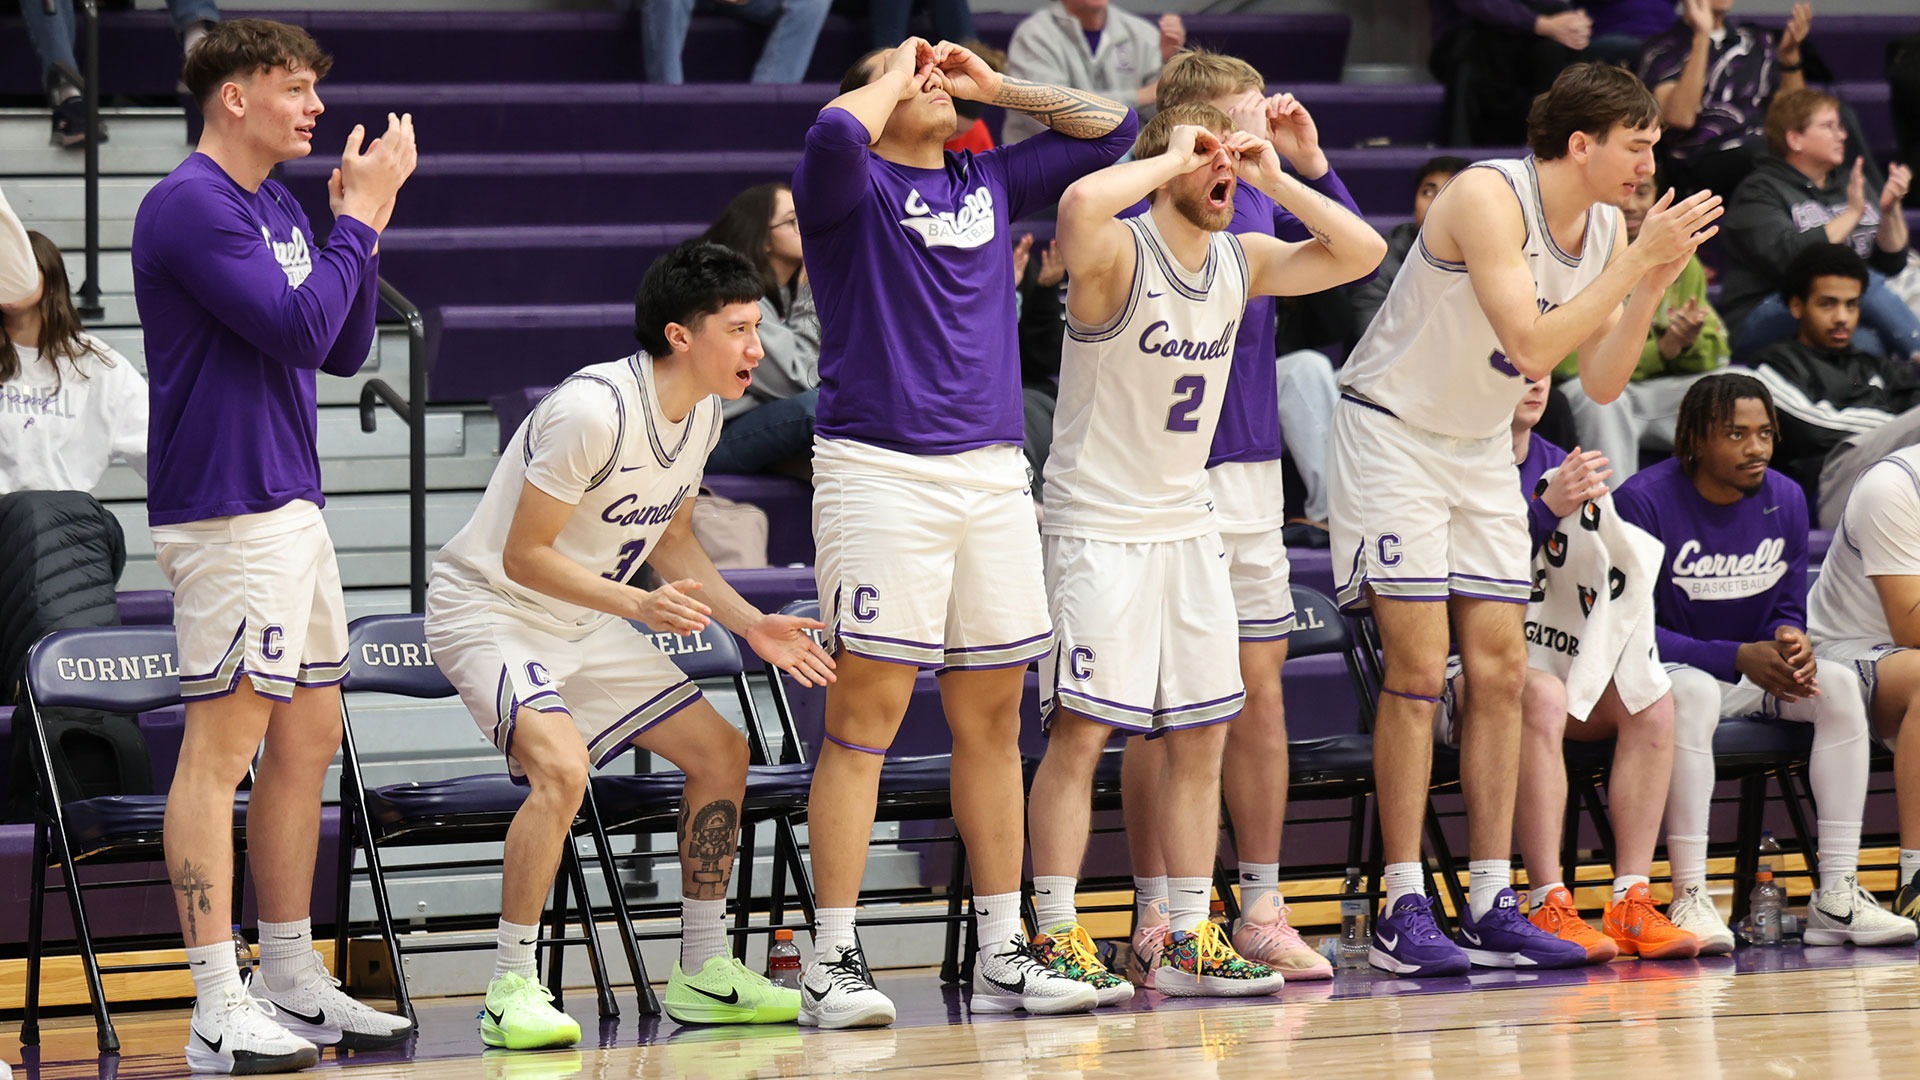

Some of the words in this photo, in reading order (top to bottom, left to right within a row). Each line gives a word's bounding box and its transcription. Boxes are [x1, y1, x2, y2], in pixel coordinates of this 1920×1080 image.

[1138, 319, 1236, 361] Cornell
[1163, 373, 1207, 434] 2
[601, 484, 691, 527] Cornell
[600, 537, 647, 583] 3
[1375, 532, 1403, 568] C
[1672, 537, 1786, 578] Cornell
[852, 583, 880, 623] C
[1691, 578, 1768, 594] BASKETBALL
[258, 623, 286, 663] C
[1069, 644, 1096, 682] C
[523, 659, 551, 688] C
